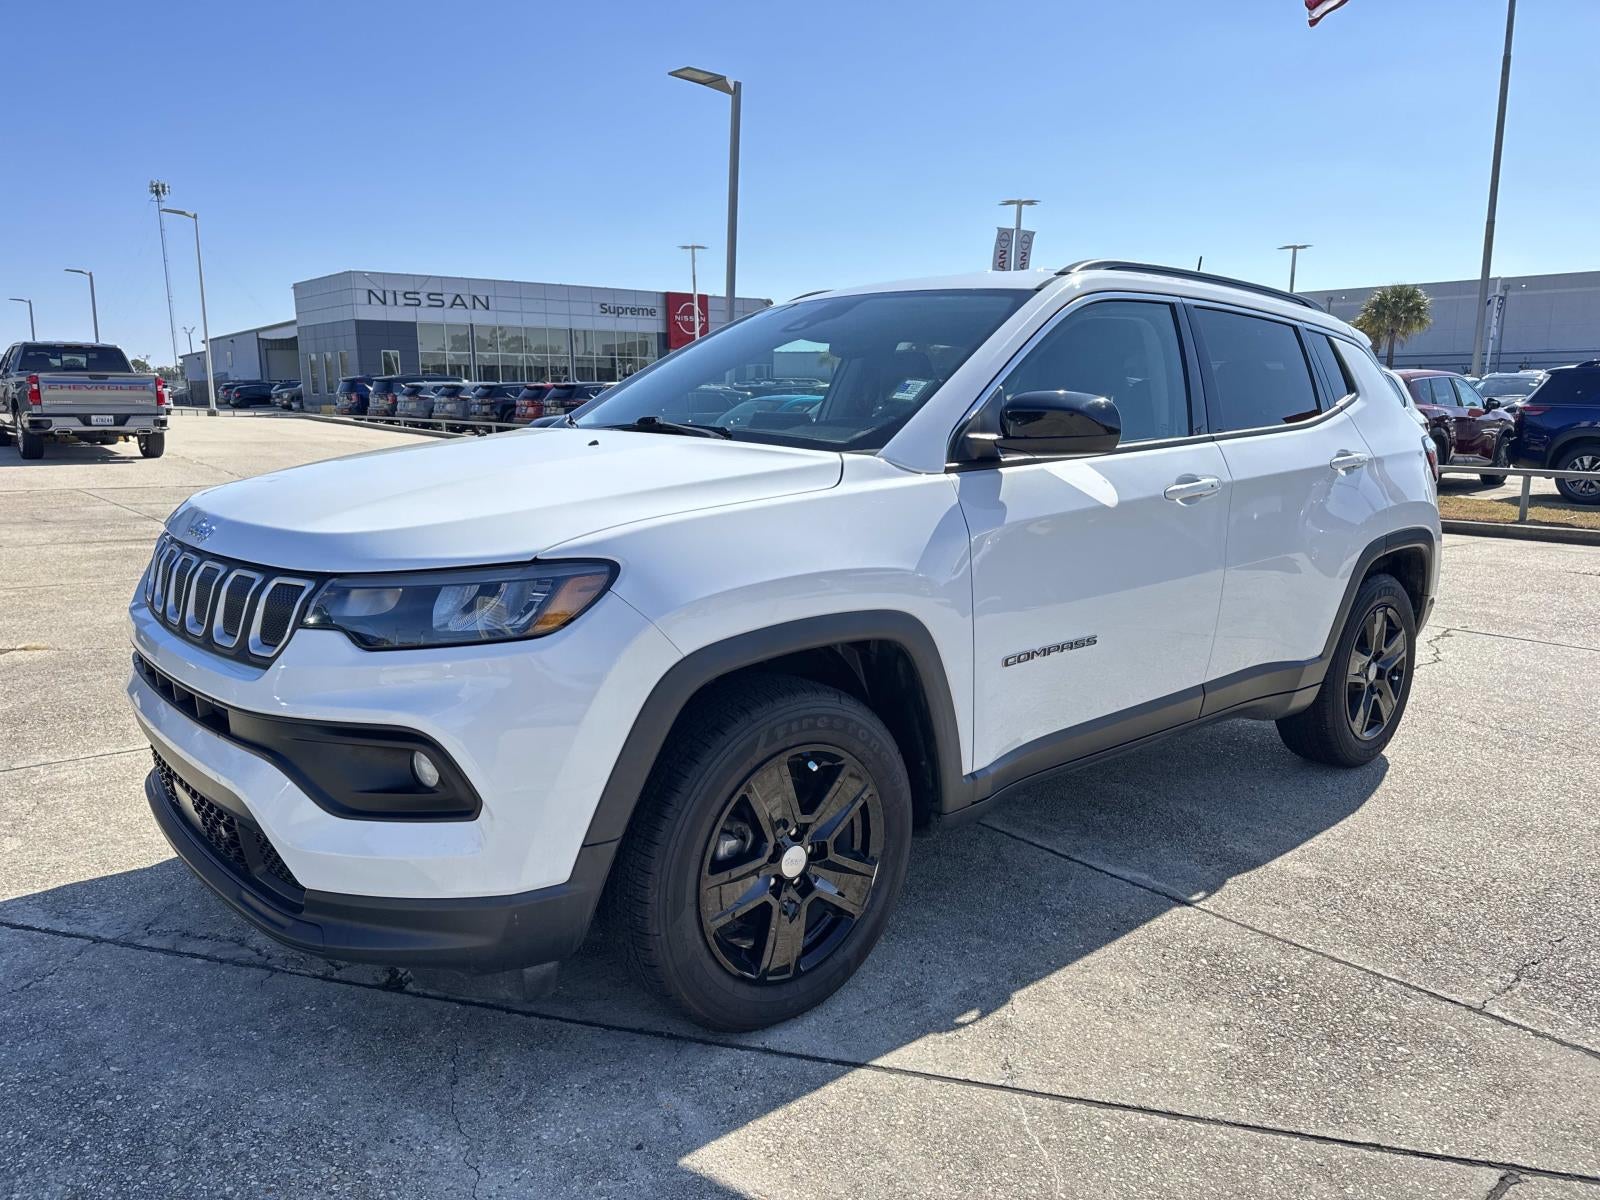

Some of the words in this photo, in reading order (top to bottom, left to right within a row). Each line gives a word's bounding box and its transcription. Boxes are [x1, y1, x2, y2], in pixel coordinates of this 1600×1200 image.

[367, 289, 490, 311] NISSAN
[600, 303, 657, 318] Supreme
[674, 314, 706, 323] NISSN
[1002, 634, 1098, 668] COMPASS
